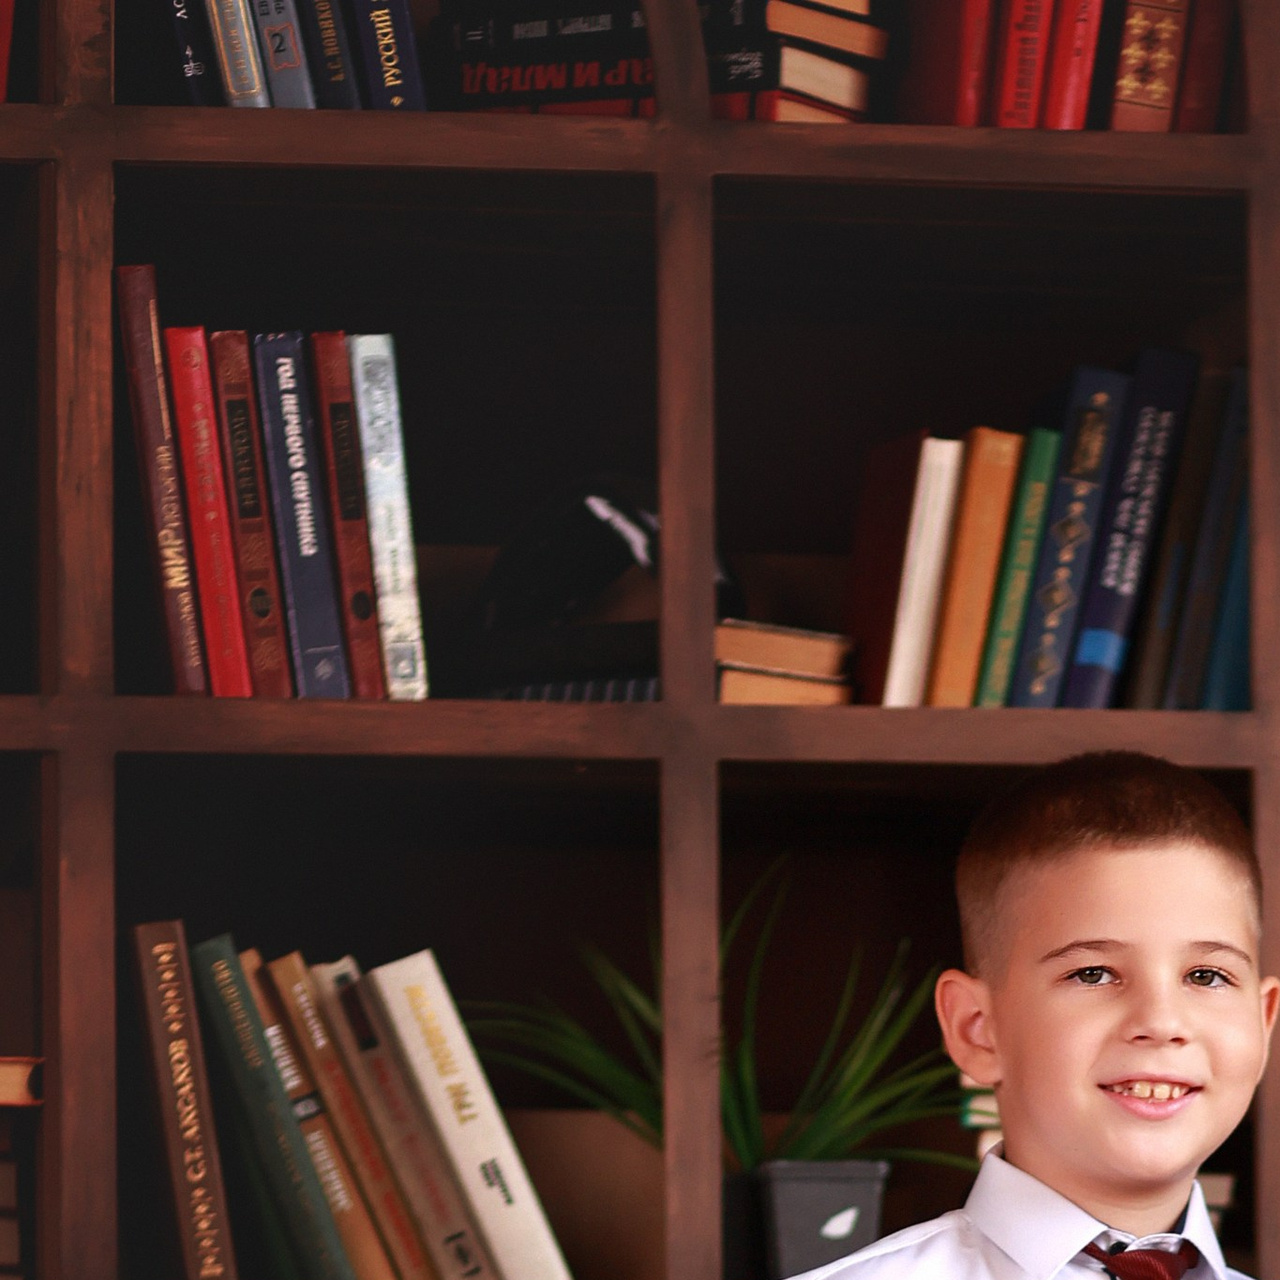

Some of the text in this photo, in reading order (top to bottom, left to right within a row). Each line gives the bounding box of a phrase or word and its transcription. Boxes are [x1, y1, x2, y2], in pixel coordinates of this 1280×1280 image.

[369, 8, 402, 87] РУССКИЙ
[275, 356, 317, 558] ГОД ПЕРВОГО СПУТНИКА
[166, 1037, 206, 1142] АКСАКОВ
